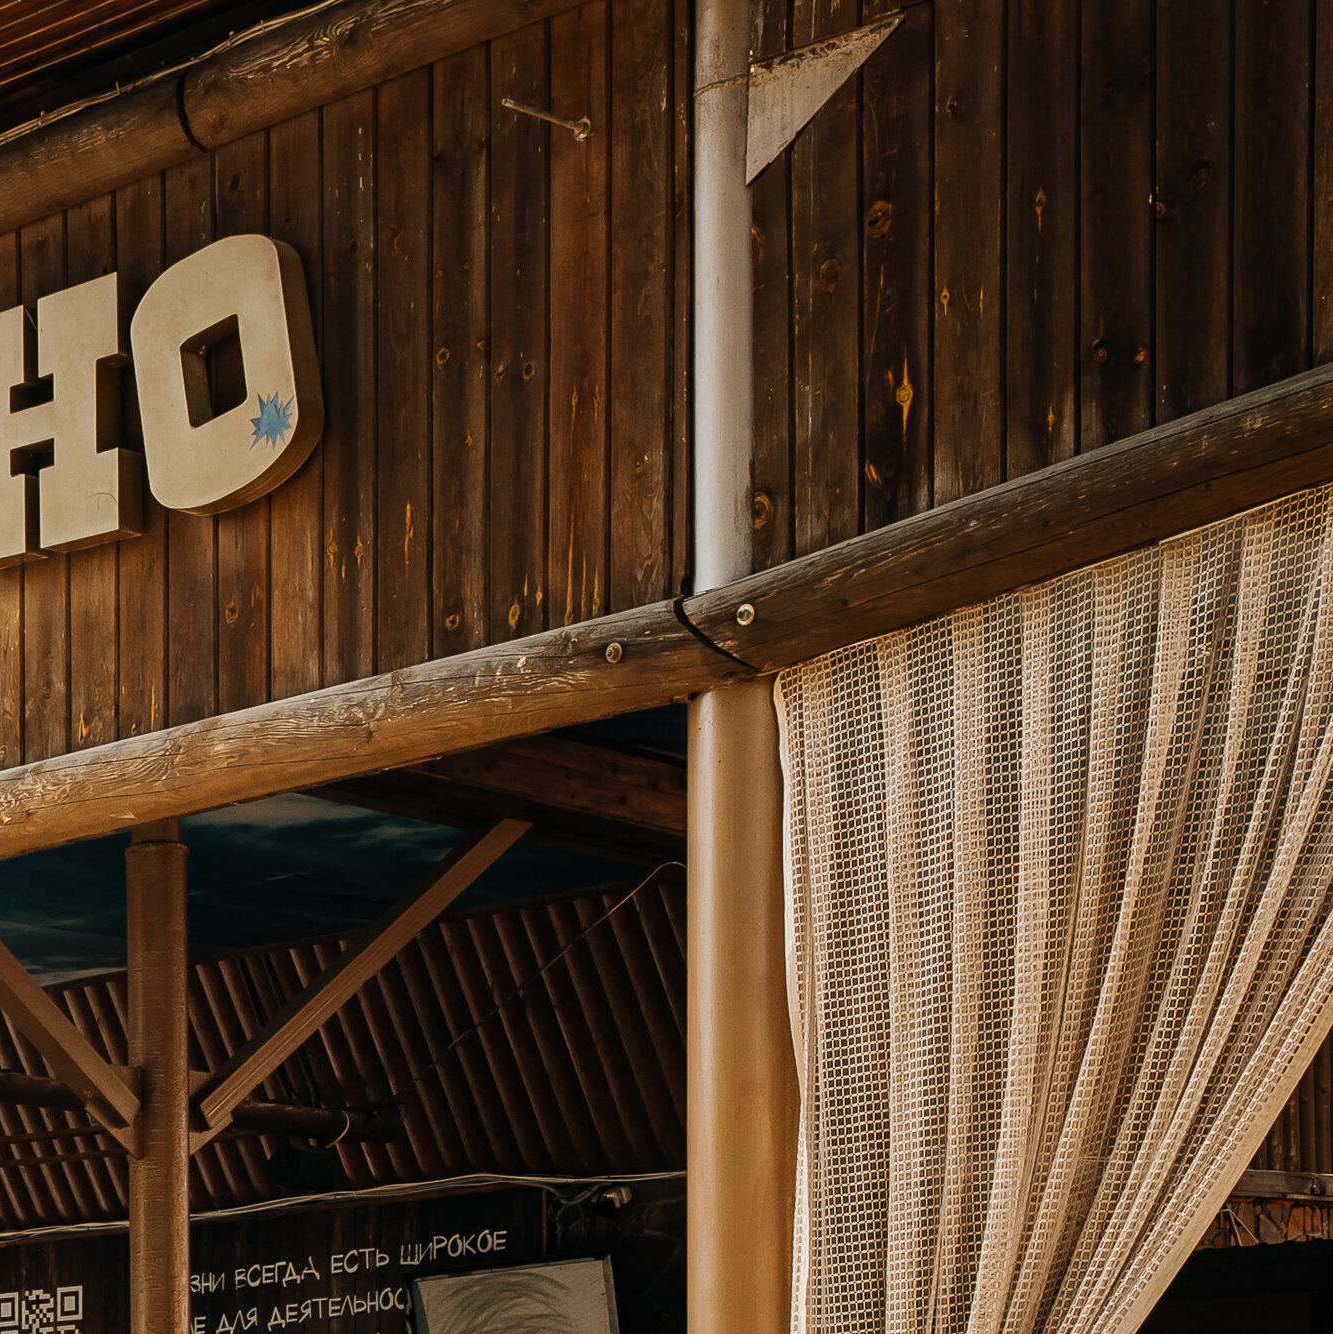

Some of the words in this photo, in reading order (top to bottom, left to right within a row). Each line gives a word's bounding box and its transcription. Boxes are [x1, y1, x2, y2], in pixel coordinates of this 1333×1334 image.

[190, 1272, 225, 1294] ЗНИ
[235, 1256, 320, 1290] ВСЕГДА
[331, 1247, 390, 1274] ЕСТЬ
[400, 1230, 507, 1265] ШИРОКОЕ
[268, 1287, 405, 1332] ДЕЯТЕЛЬНОС
